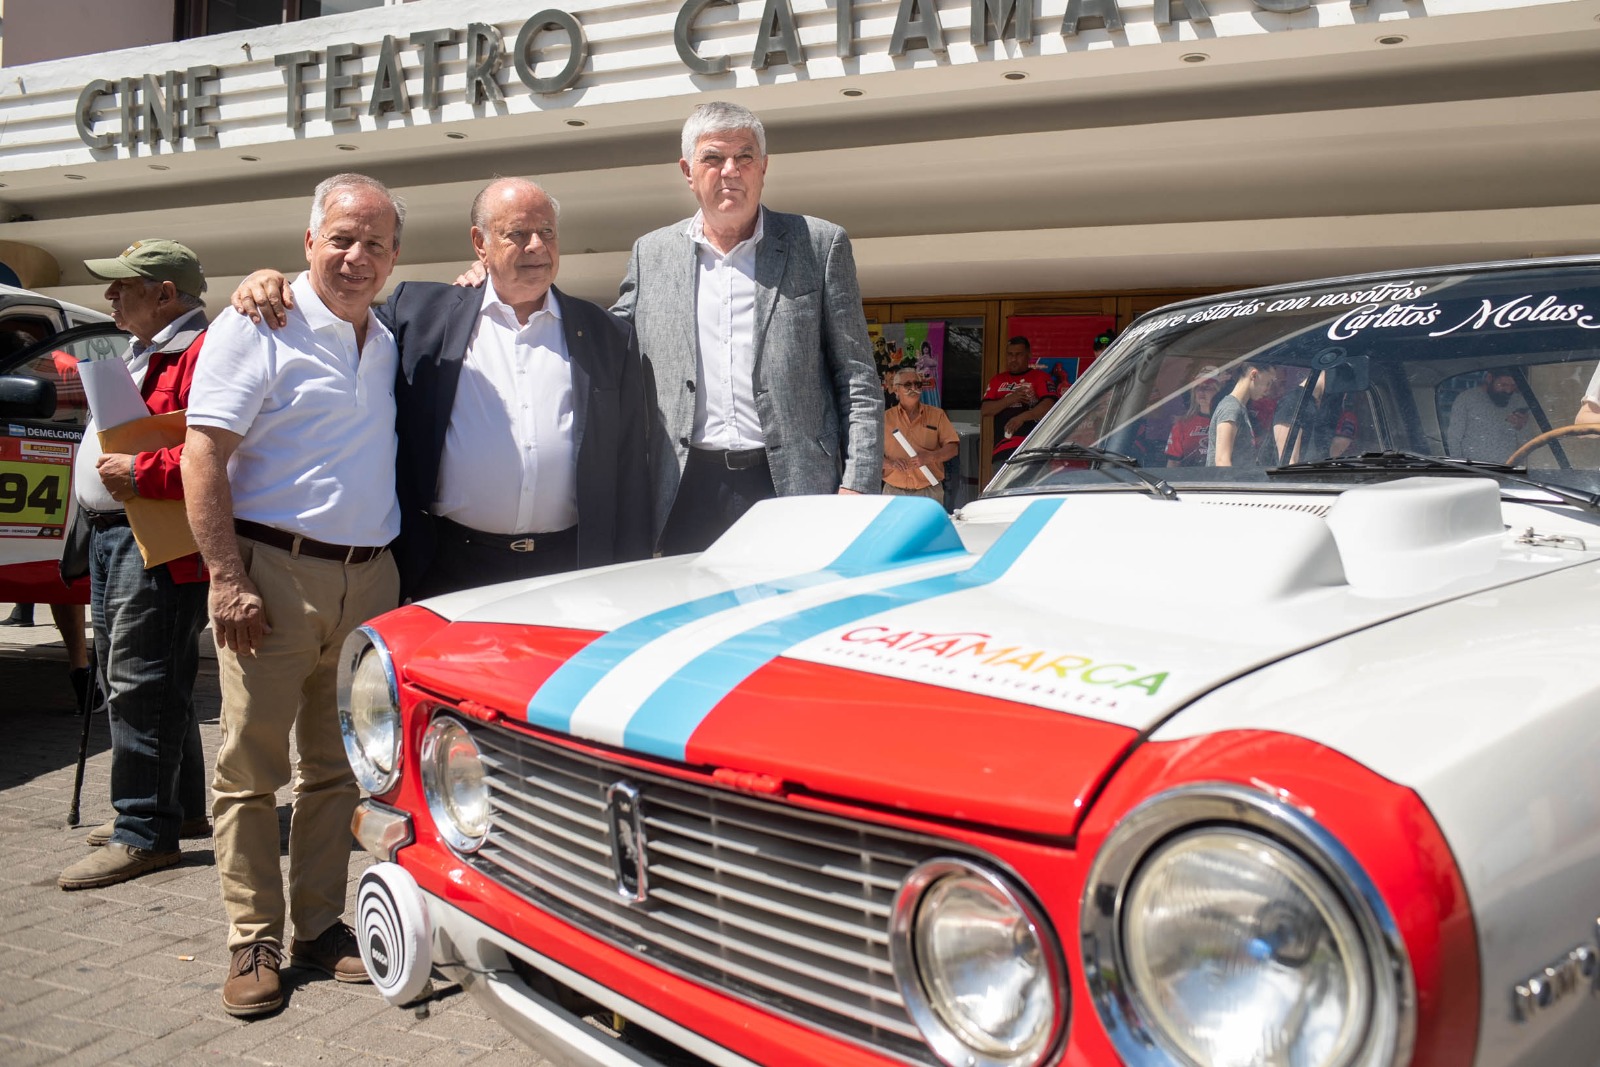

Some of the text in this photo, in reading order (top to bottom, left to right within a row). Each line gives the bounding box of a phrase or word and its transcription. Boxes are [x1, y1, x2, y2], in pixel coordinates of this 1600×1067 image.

[75, 64, 220, 150] CINE
[274, 8, 590, 130] TEATRO
[1187, 299, 1266, 324] estarás
[1266, 297, 1310, 314] con
[1311, 281, 1428, 308] nosotros
[1327, 294, 1600, 341] Carlitos Molas
[0, 473, 62, 514] 94
[841, 626, 1170, 697] CATAMARCA
